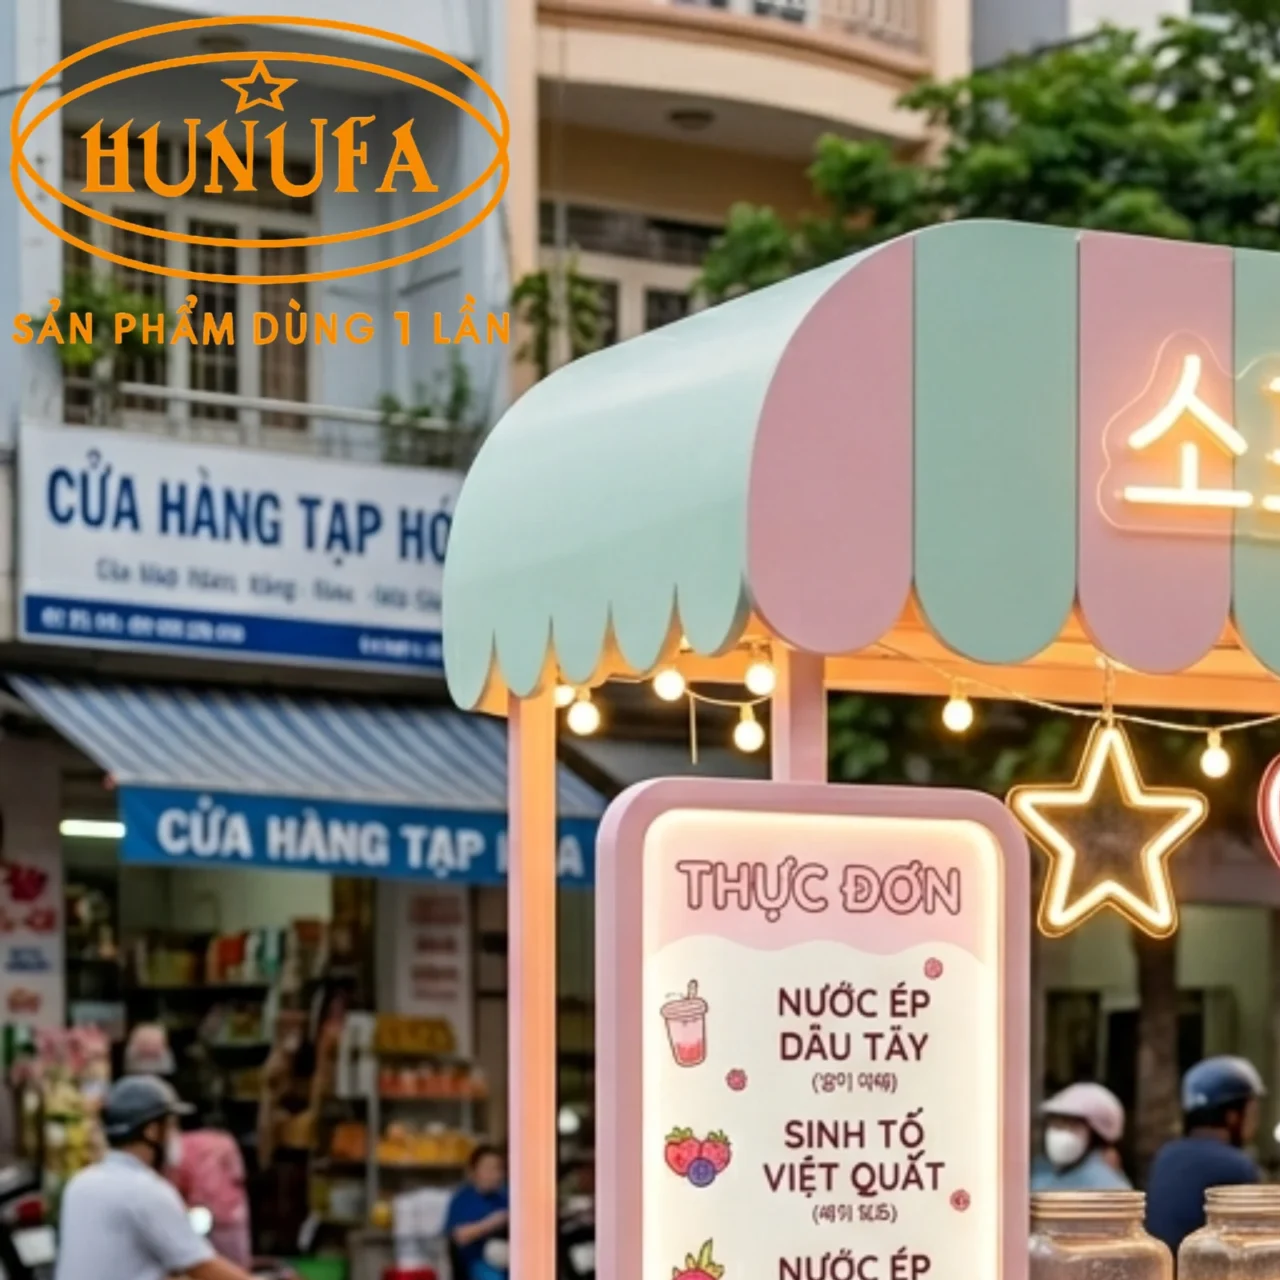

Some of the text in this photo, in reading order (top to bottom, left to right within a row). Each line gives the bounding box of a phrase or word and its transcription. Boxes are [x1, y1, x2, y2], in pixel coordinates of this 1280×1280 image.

[47, 449, 453, 567] CỬA HÀNG TẠP HÓ
[156, 794, 254, 860] CỬA
[264, 806, 391, 868] HÀNG
[398, 823, 487, 880] TẠP
[675, 855, 961, 923] THỰC ĐƠN
[889, 980, 932, 1019] ÉP
[784, 1106, 926, 1149] SINH TỐ
